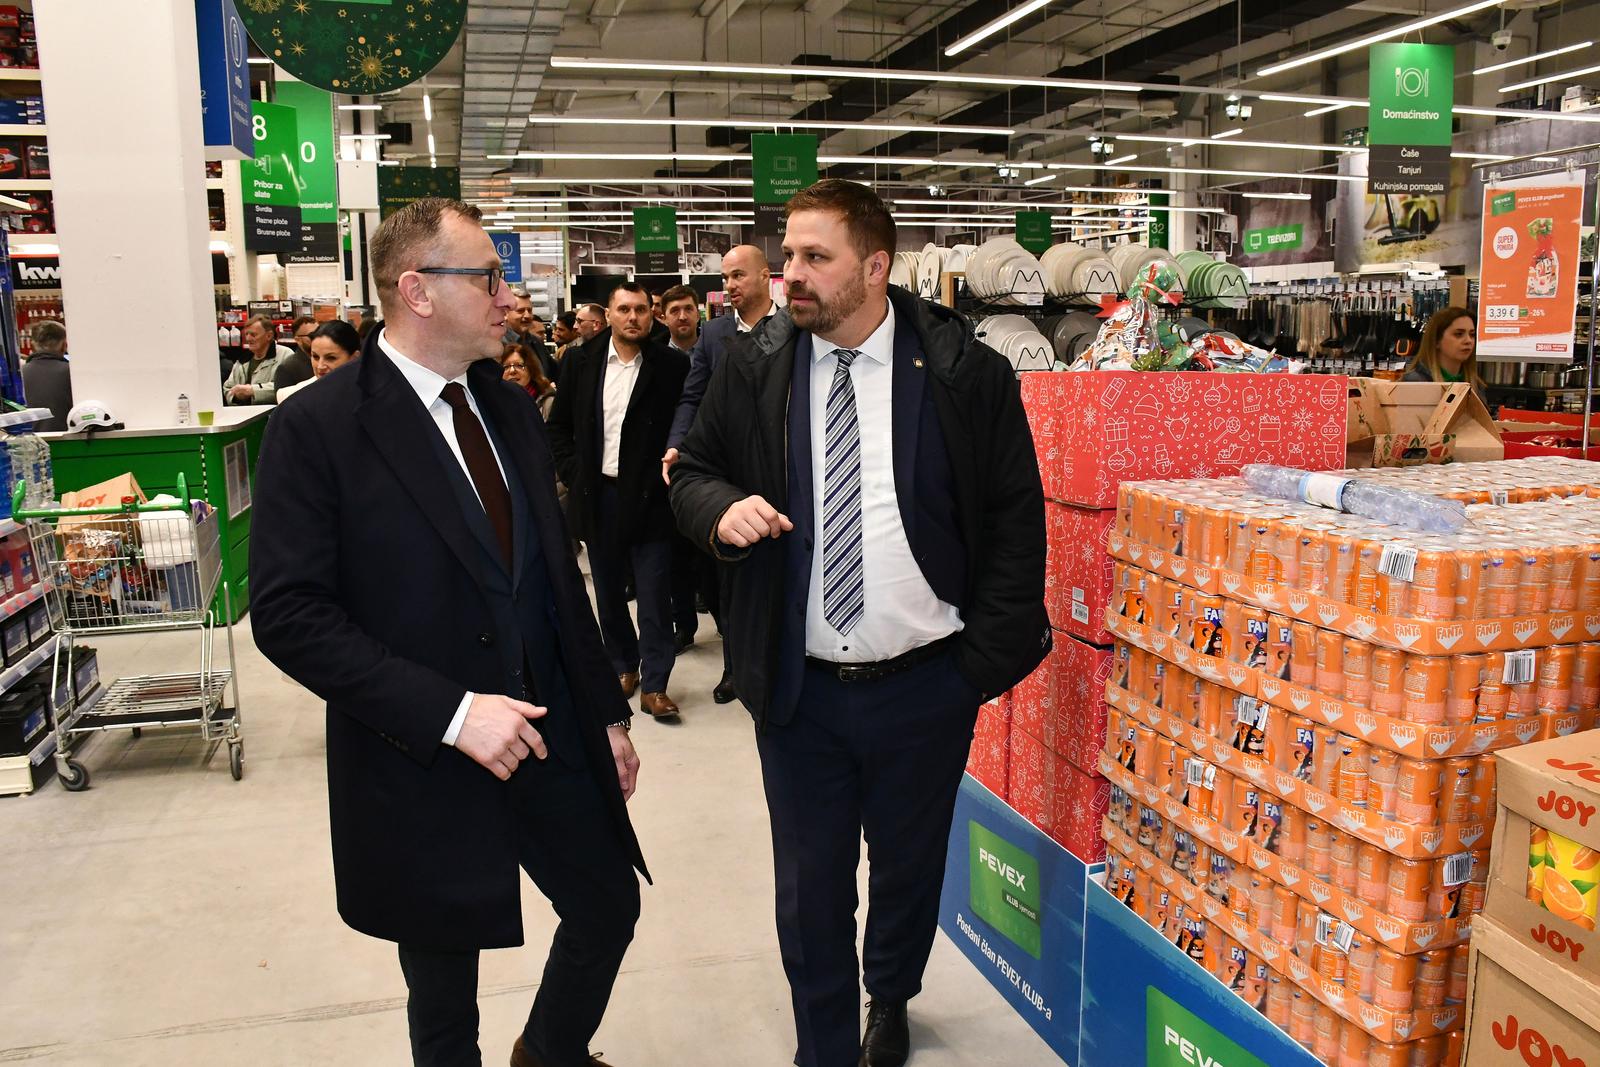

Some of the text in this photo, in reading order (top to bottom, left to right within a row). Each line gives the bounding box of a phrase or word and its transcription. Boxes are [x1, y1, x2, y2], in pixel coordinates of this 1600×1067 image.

[1382, 108, 1440, 120] Domaćinstvo
[252, 114, 267, 140] 8
[1401, 147, 1419, 158] Čaše
[1398, 165, 1422, 175] Tanjuri
[254, 180, 274, 189] Pribor
[1374, 182, 1444, 192] Kuhinjska pomagala
[1151, 223, 1164, 234] 32
[1267, 232, 1296, 244] TELEVIZORI
[1498, 235, 1513, 243] SUPER
[1489, 308, 1515, 319] 3,39 €
[1476, 622, 1501, 635] FANTA
[1513, 618, 1538, 633] FANTA
[1550, 616, 1574, 630] FANTA
[1394, 624, 1421, 636] FANTA
[1436, 624, 1463, 638] FANTA
[1355, 712, 1377, 725] FANTA
[1516, 717, 1540, 730] FANTA
[1389, 724, 1416, 737] FANTA
[1430, 732, 1455, 744] FANTA
[1538, 790, 1596, 827] JOY
[1459, 826, 1483, 840] FANTA
[979, 847, 1026, 891] PEVEX
[1006, 894, 1018, 908] KLUB
[1375, 916, 1400, 933] FANTA
[1531, 924, 1584, 962] JOY
[956, 913, 1052, 1021] Postani član PEVEX KLUB-a
[1164, 1024, 1224, 1067] PEV
